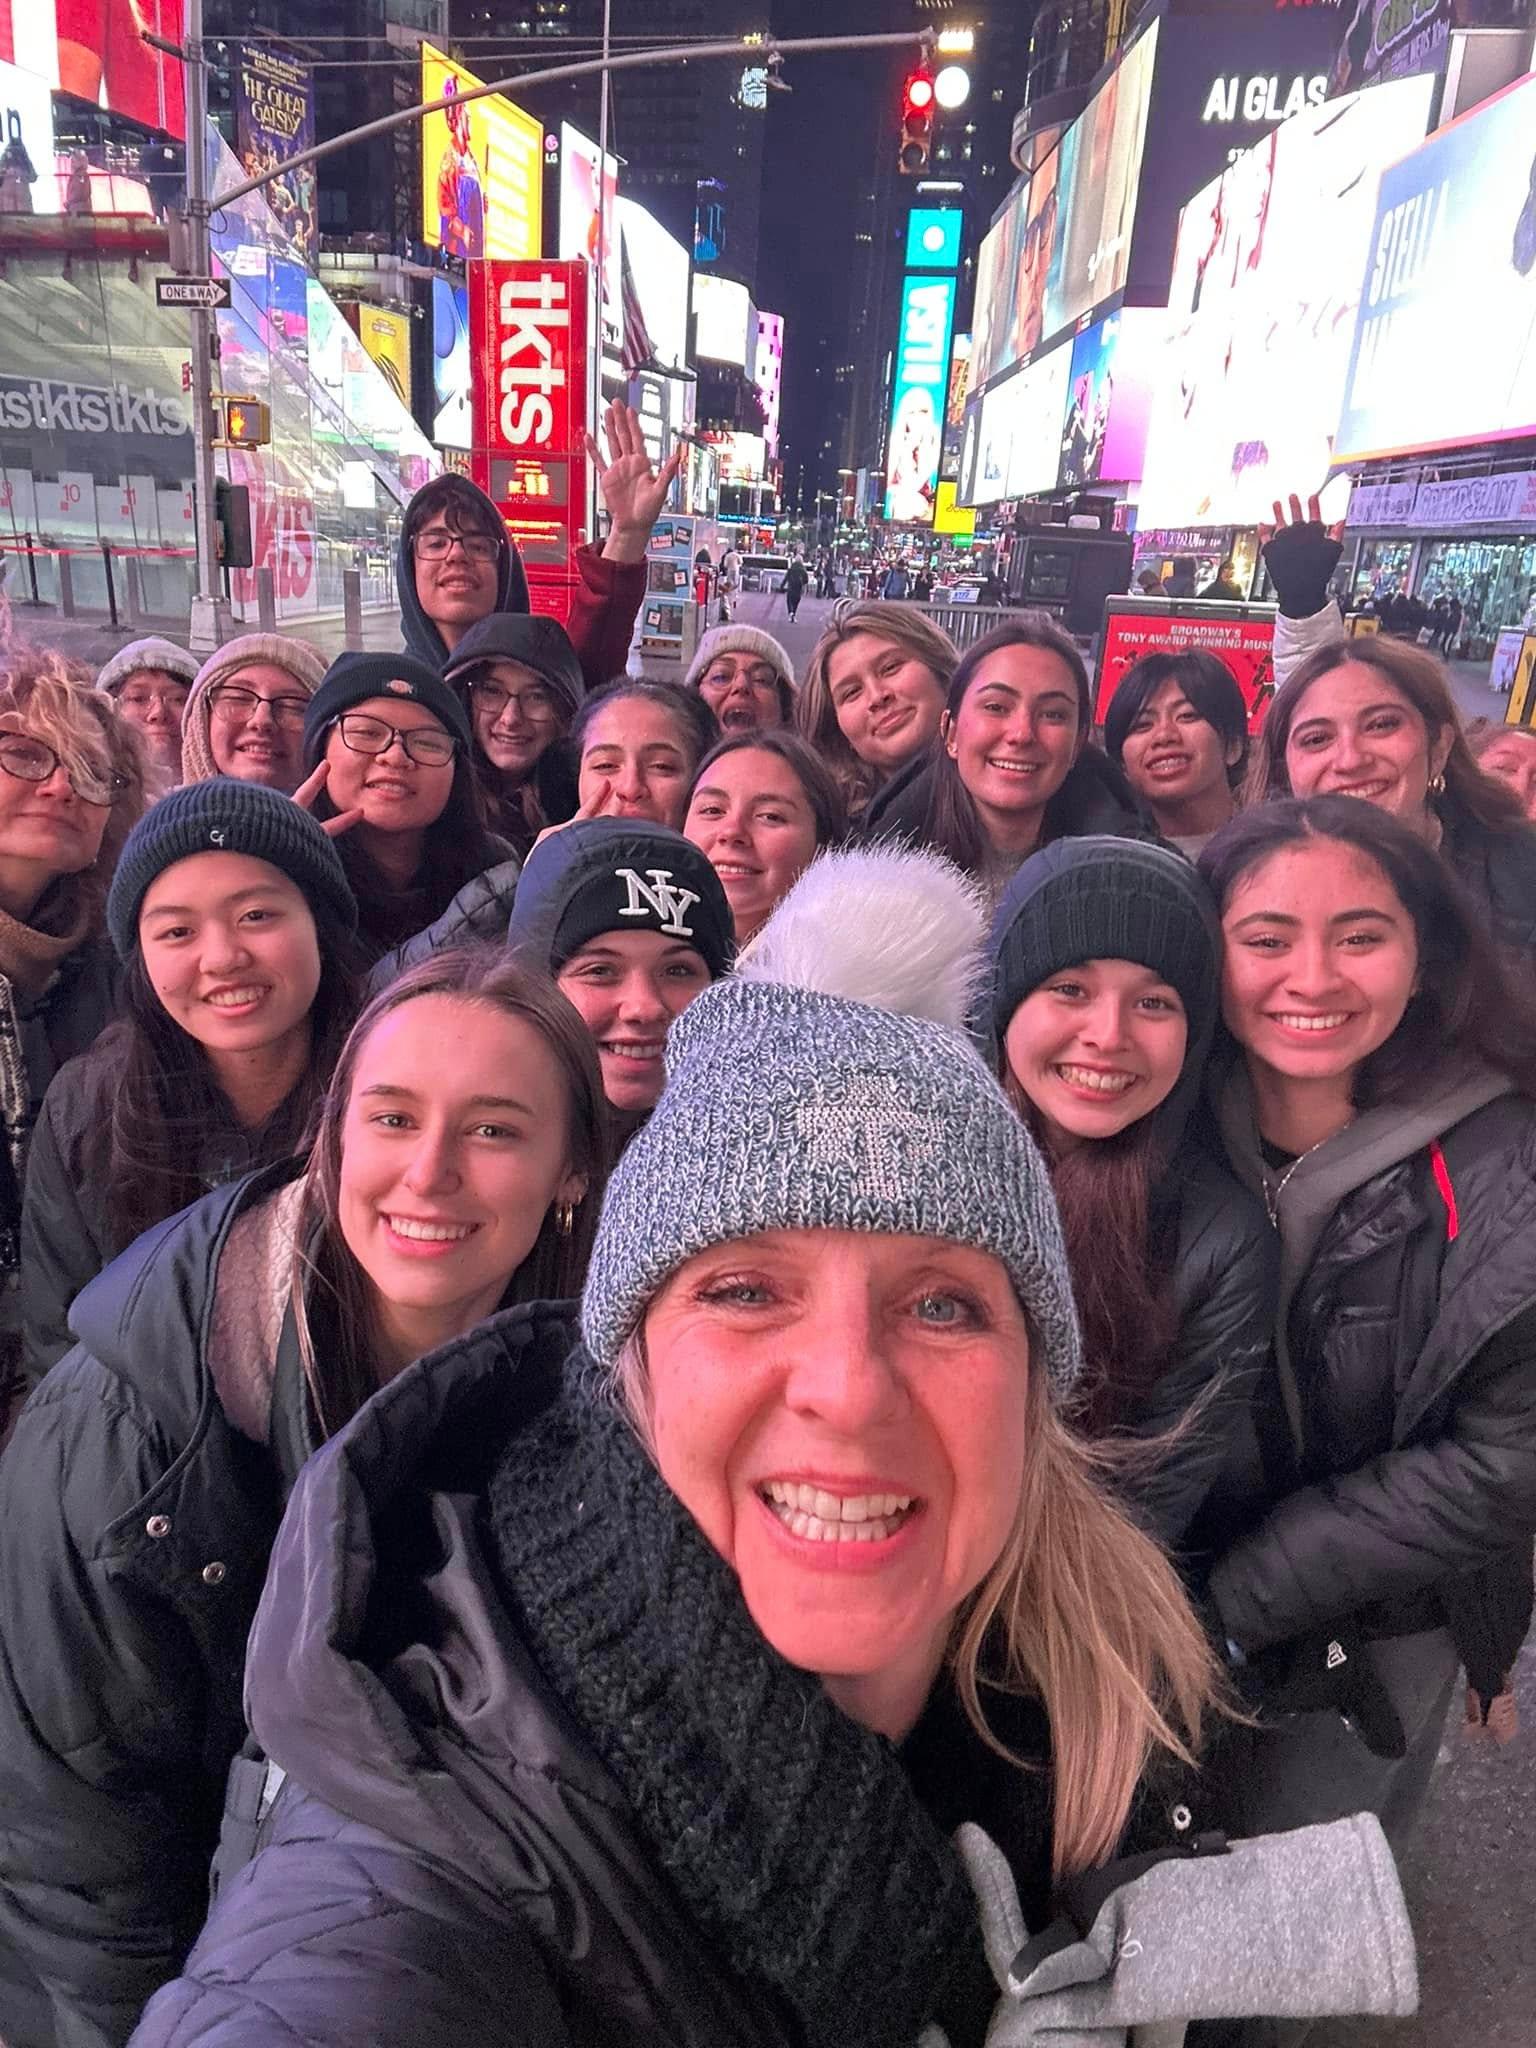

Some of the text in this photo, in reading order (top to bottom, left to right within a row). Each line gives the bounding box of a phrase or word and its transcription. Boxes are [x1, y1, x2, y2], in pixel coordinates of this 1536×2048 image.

[242, 72, 267, 103] THE
[267, 86, 307, 119] GREAT
[1203, 76, 1240, 121] AI
[251, 100, 302, 135] GATSBY
[545, 152, 559, 164] LG
[166, 286, 220, 299] ONE WAY
[488, 288, 496, 321] service
[488, 333, 497, 364] theatre
[500, 273, 569, 445] tkts
[63, 484, 81, 503] 10
[1118, 632, 1148, 644] TONY
[1170, 624, 1242, 639] BROADWAY'S
[614, 868, 701, 937] NY
